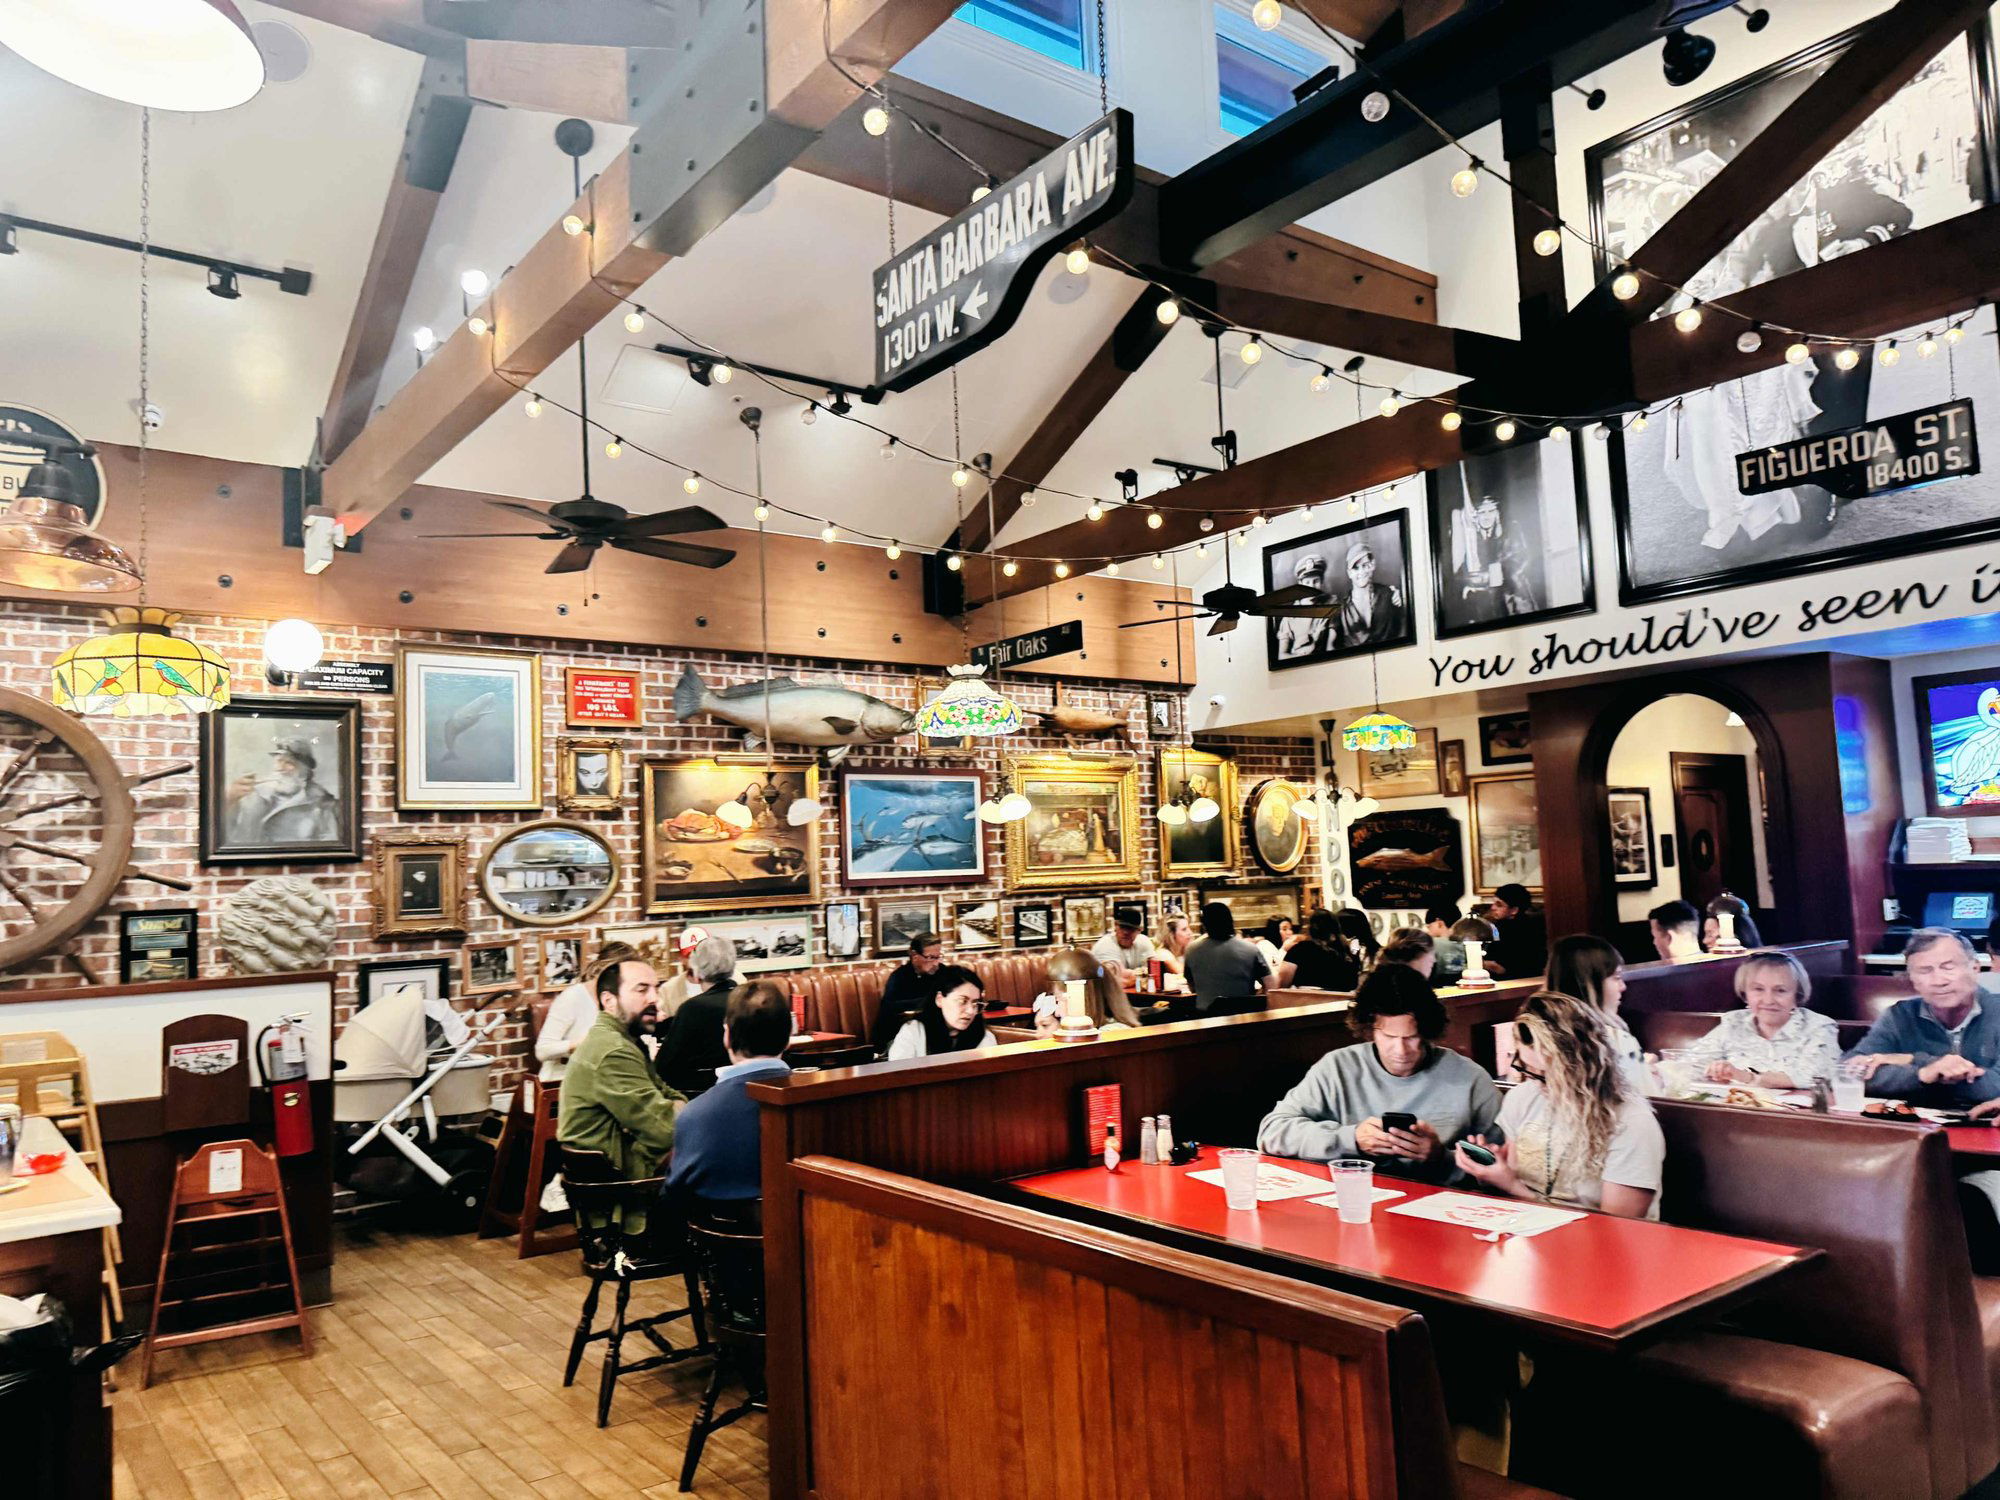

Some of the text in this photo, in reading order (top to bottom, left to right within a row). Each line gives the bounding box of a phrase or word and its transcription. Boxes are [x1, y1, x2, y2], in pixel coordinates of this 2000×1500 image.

[876, 127, 1116, 329] SANTA BARBARA AVE.
[884, 295, 960, 373] 1300 W.
[1741, 407, 1970, 489] FIGUEROA ST.
[1867, 446, 1971, 488] 18400 S.
[988, 643, 1012, 666] Fair
[1016, 636, 1048, 659] Oaks
[1429, 655, 1515, 687] You
[1528, 607, 1781, 675] should've
[1798, 582, 1950, 632] seen
[332, 675, 371, 684] PERSONS
[346, 668, 385, 676] CAPACITY
